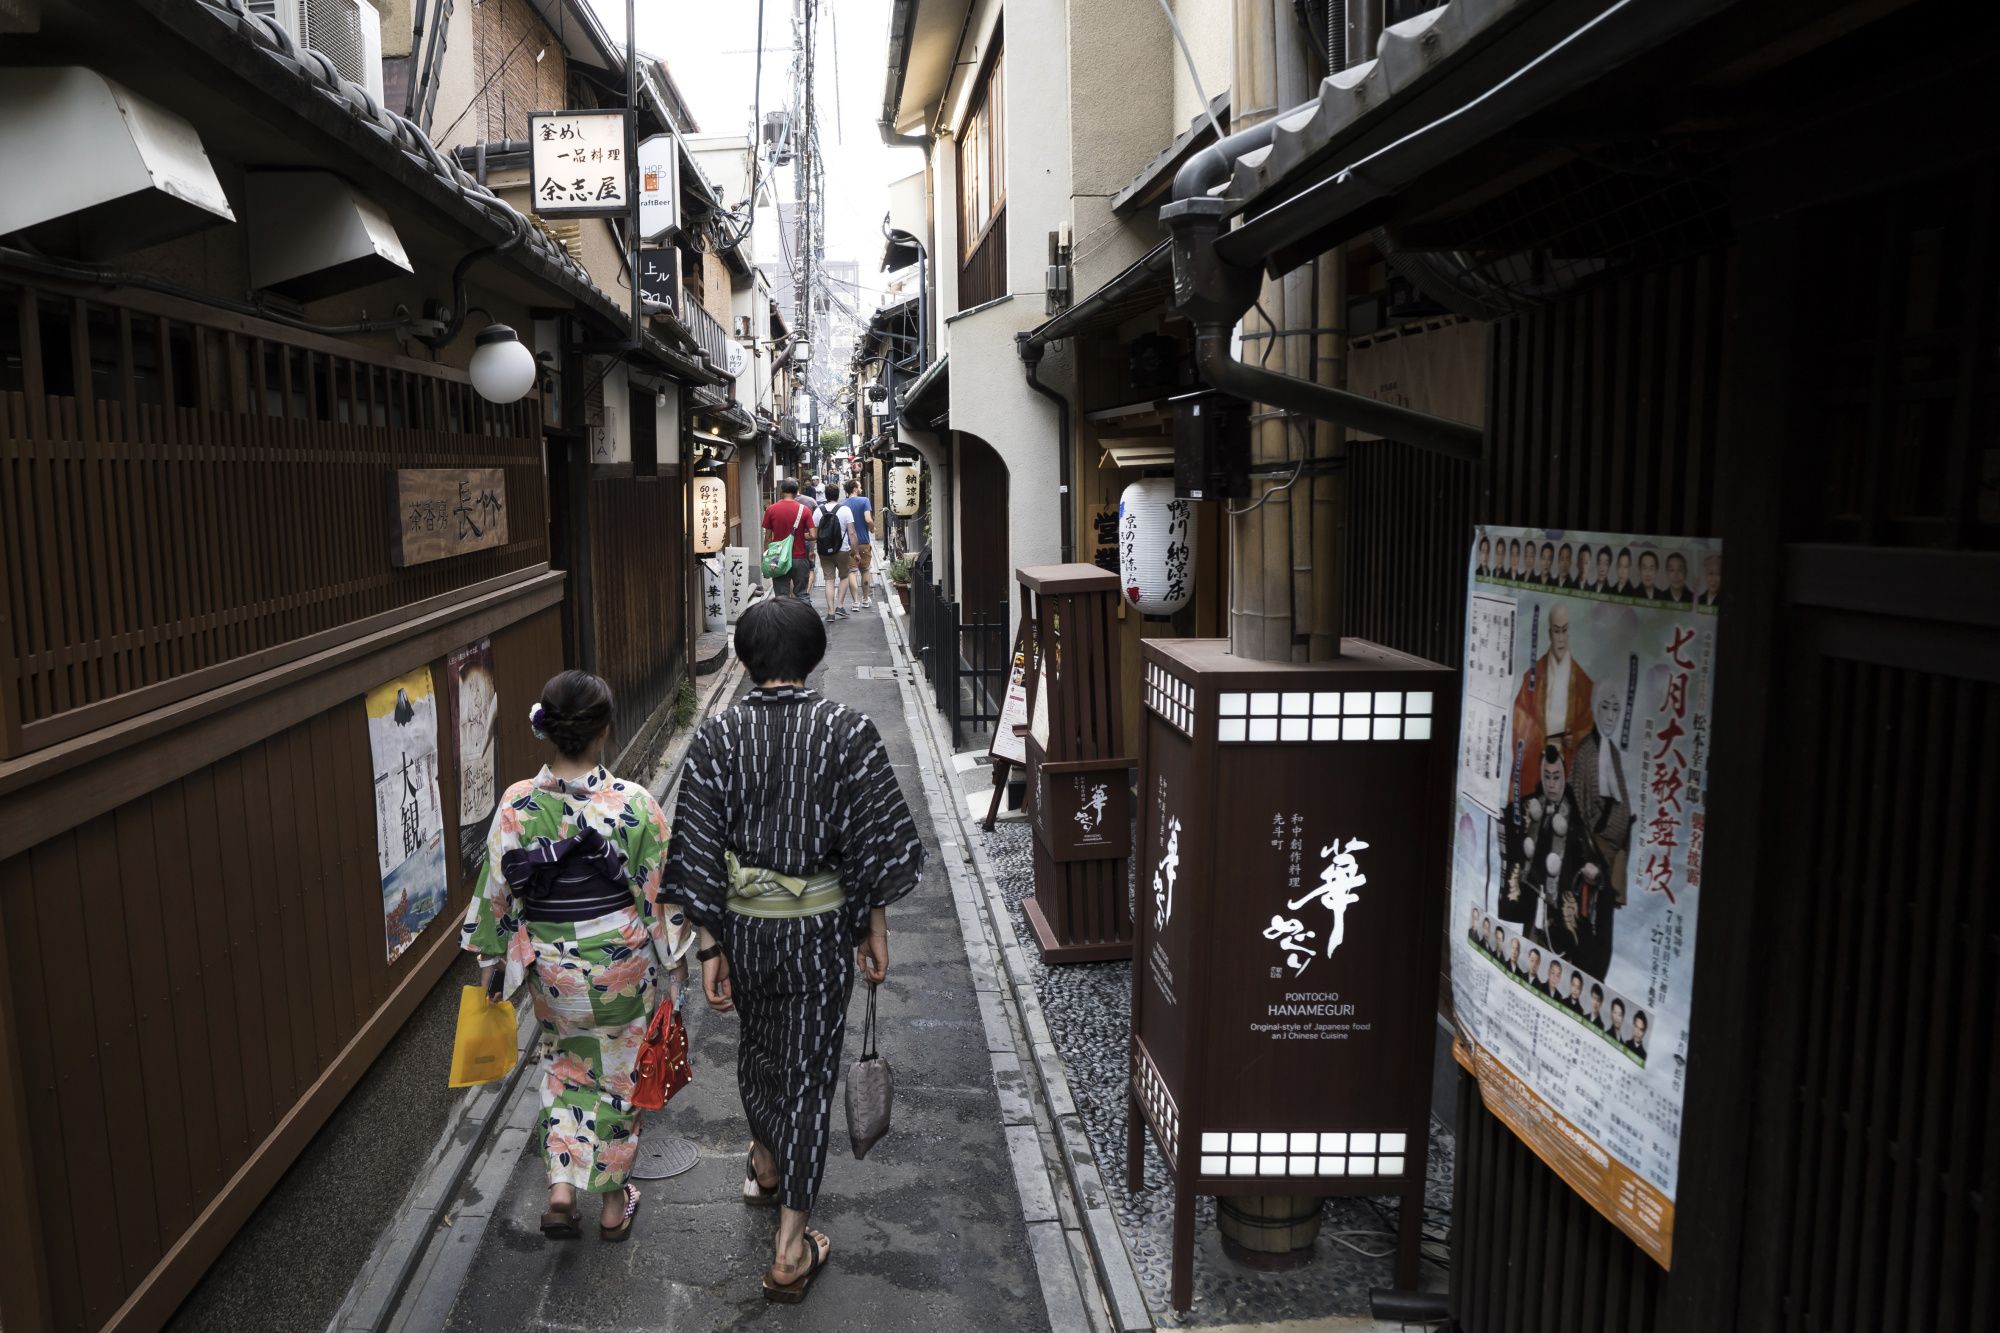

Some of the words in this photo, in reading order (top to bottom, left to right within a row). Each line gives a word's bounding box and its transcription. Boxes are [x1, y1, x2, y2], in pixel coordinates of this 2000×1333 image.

[540, 121, 586, 141] 釜めし
[557, 148, 620, 163] 一品料理
[540, 176, 621, 201] 余志屋
[1646, 626, 1695, 904] 七月大歌舞伎
[397, 752, 421, 859] 大観
[1271, 812, 1285, 850] 先斗町
[1288, 813, 1304, 888] 和中創作料理
[1285, 992, 1339, 1001] PONTOCHO
[1268, 1004, 1355, 1016] HANAMEGURI
[1288, 1032, 1319, 1040] Chinese
[1320, 1032, 1349, 1040] Cuisine
[1303, 1023, 1312, 1031] of
[1314, 1023, 1350, 1032] Japanese
[1352, 1022, 1371, 1031] food
